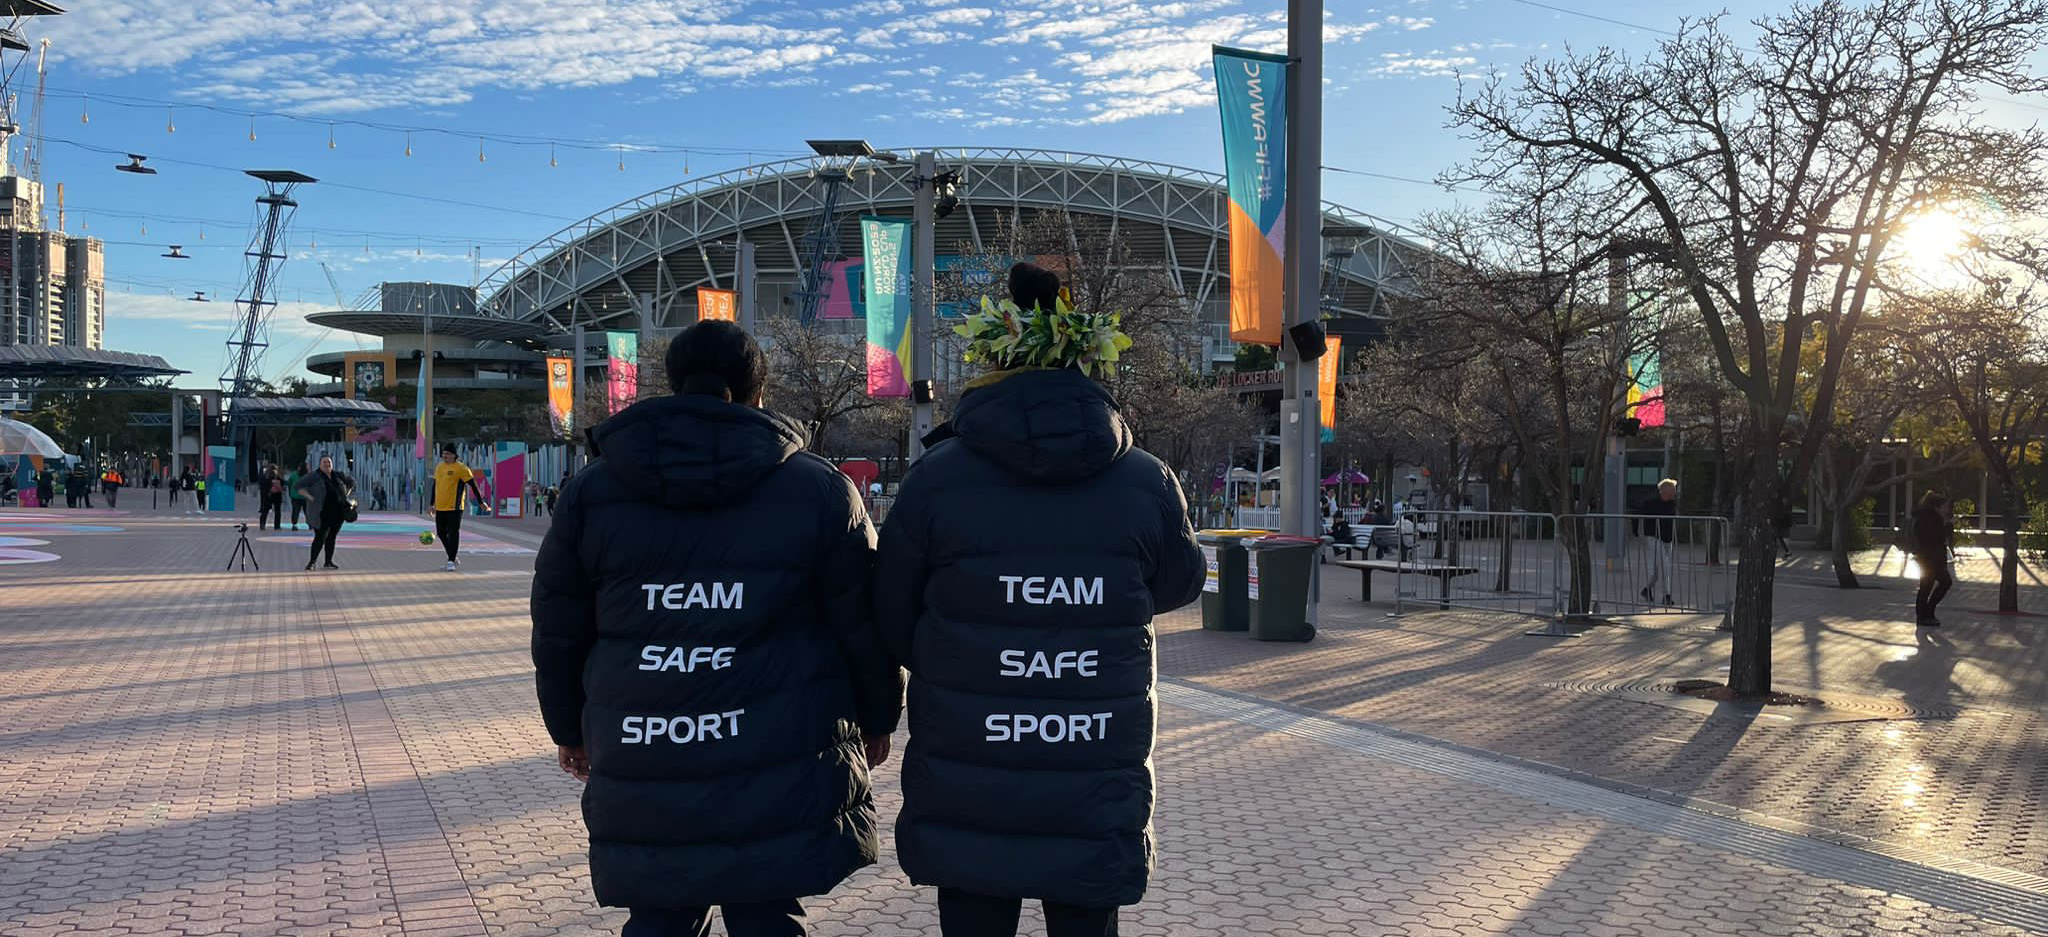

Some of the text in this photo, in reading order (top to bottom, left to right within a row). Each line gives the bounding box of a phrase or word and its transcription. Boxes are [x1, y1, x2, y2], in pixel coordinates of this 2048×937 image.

[1232, 370, 1267, 387] LOCKER
[641, 582, 744, 611] TEAM
[999, 575, 1104, 605] TEAM
[638, 645, 737, 673] SAFE
[1000, 649, 1099, 679] SAFE
[621, 708, 745, 745] SPORT
[985, 711, 1113, 743] SPORT
